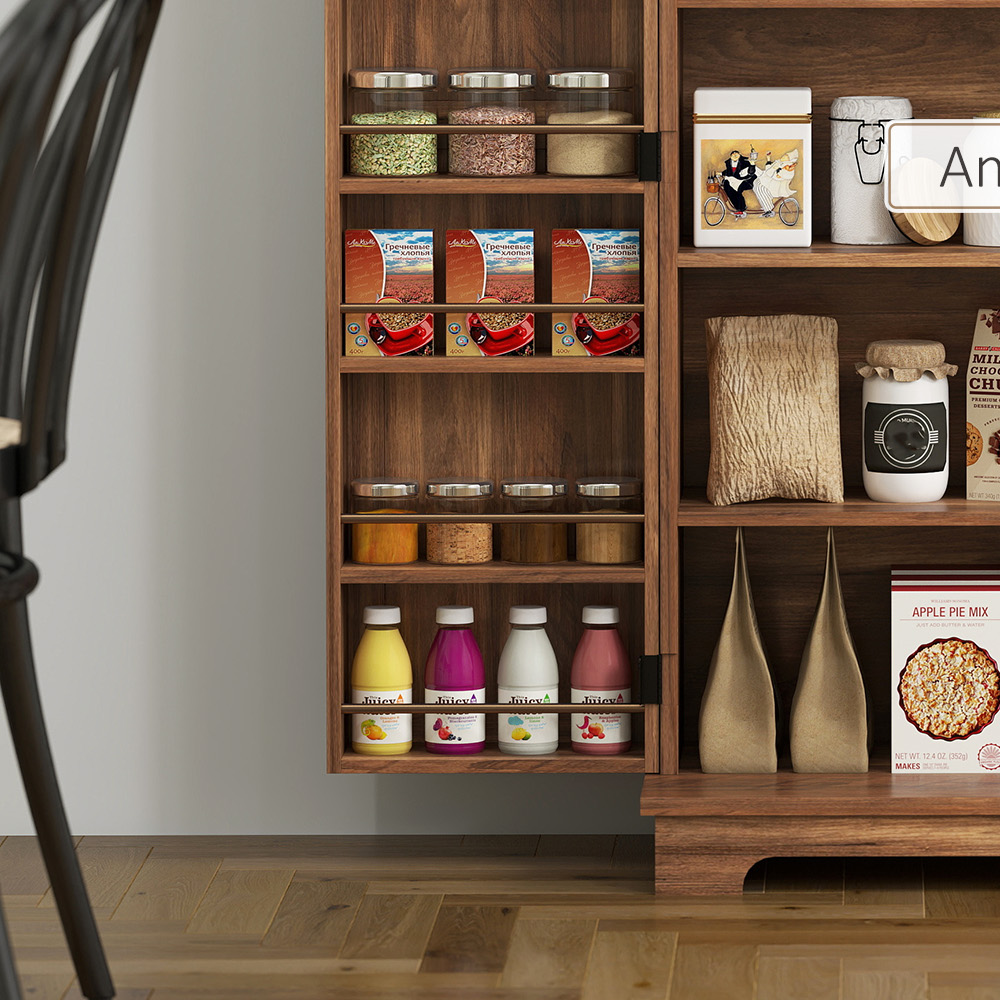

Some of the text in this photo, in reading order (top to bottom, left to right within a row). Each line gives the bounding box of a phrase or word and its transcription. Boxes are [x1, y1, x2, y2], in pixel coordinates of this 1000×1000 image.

[385, 243, 430, 251] Гречневые
[486, 243, 531, 251] Гречневые
[592, 243, 637, 251] Гречневые
[912, 607, 989, 617] APPLE PIE MIX
